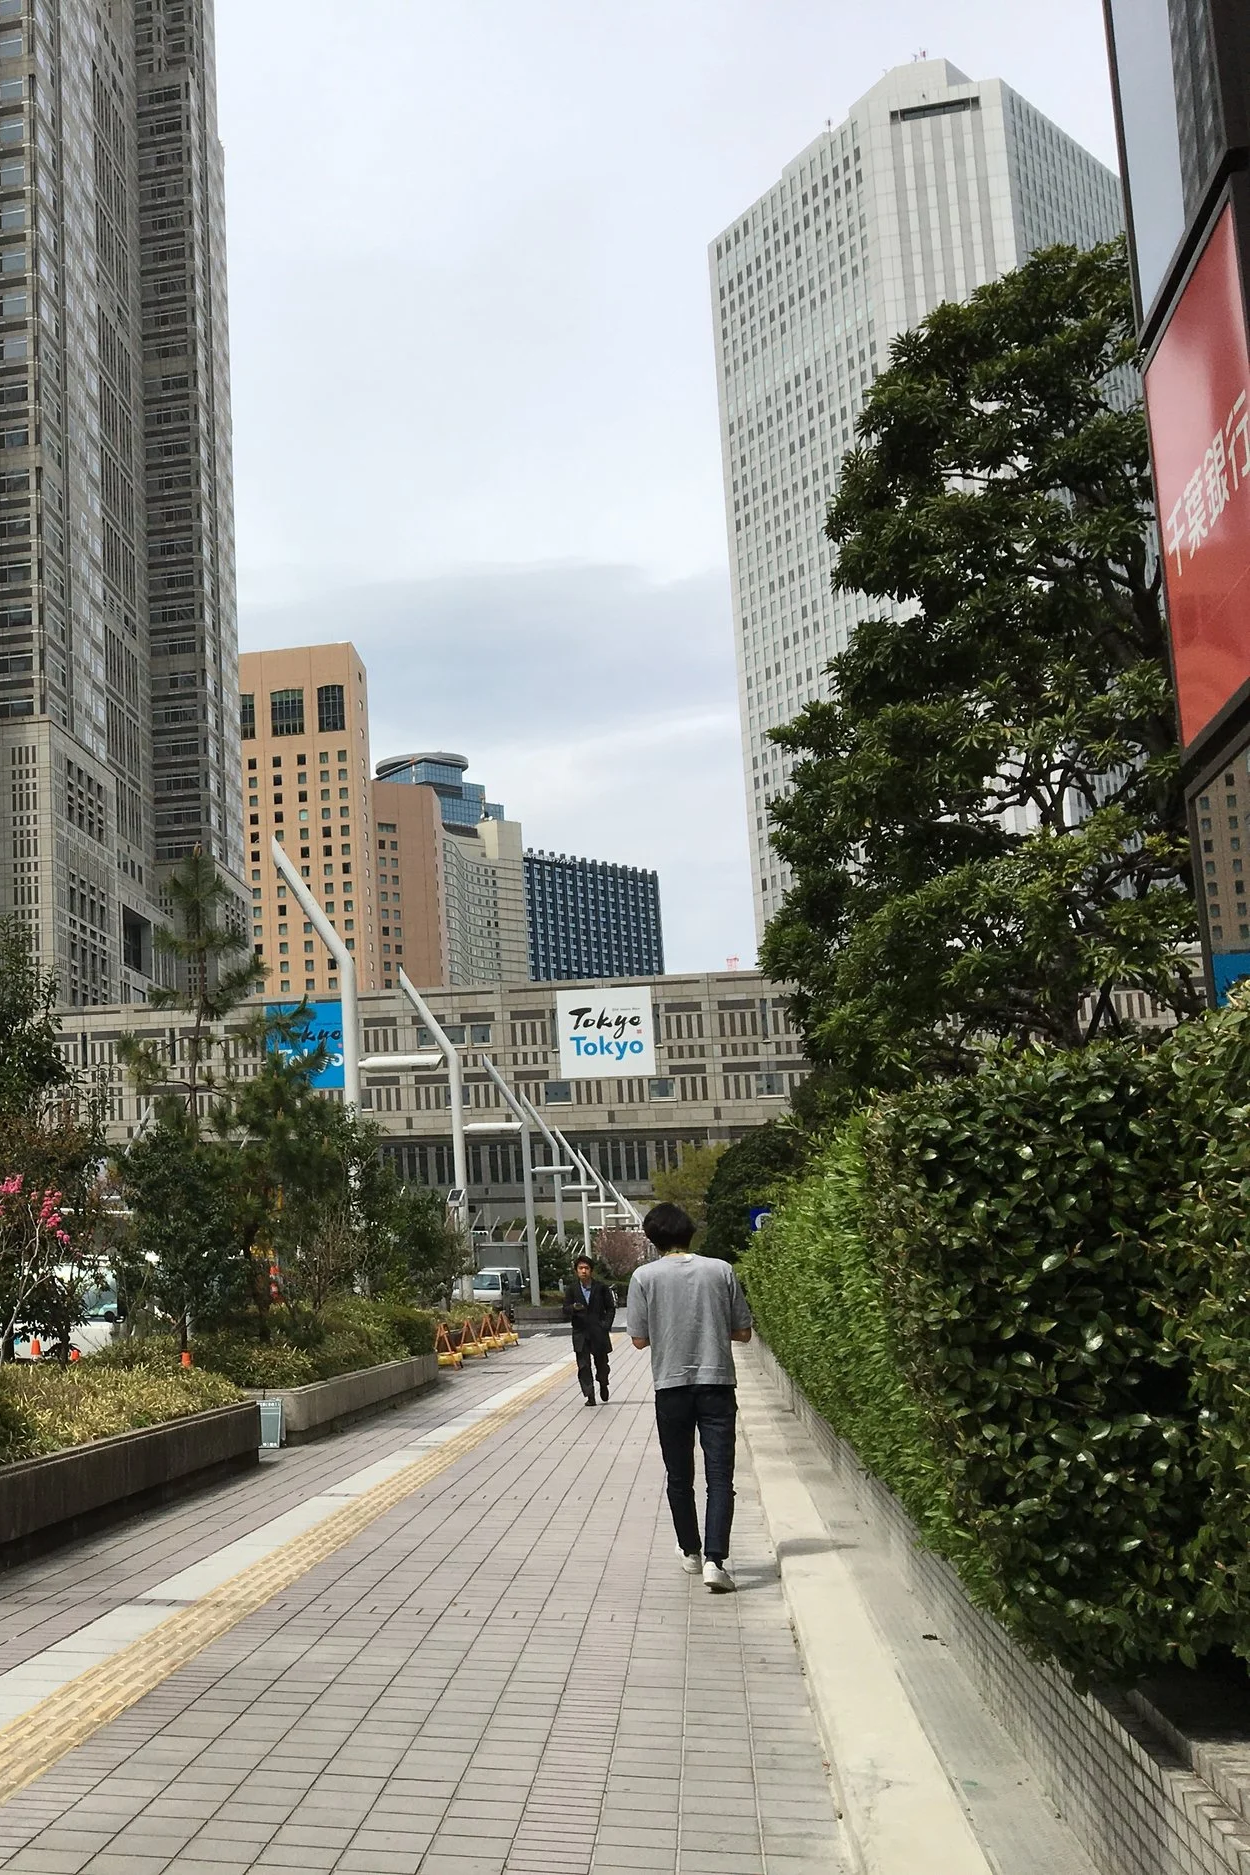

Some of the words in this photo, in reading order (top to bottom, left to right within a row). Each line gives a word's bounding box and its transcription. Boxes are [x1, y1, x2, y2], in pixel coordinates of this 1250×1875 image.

[1166, 388, 1250, 577] 千葉銀行
[568, 1007, 642, 1040] Tokyo
[569, 1035, 644, 1061] Tokyo
